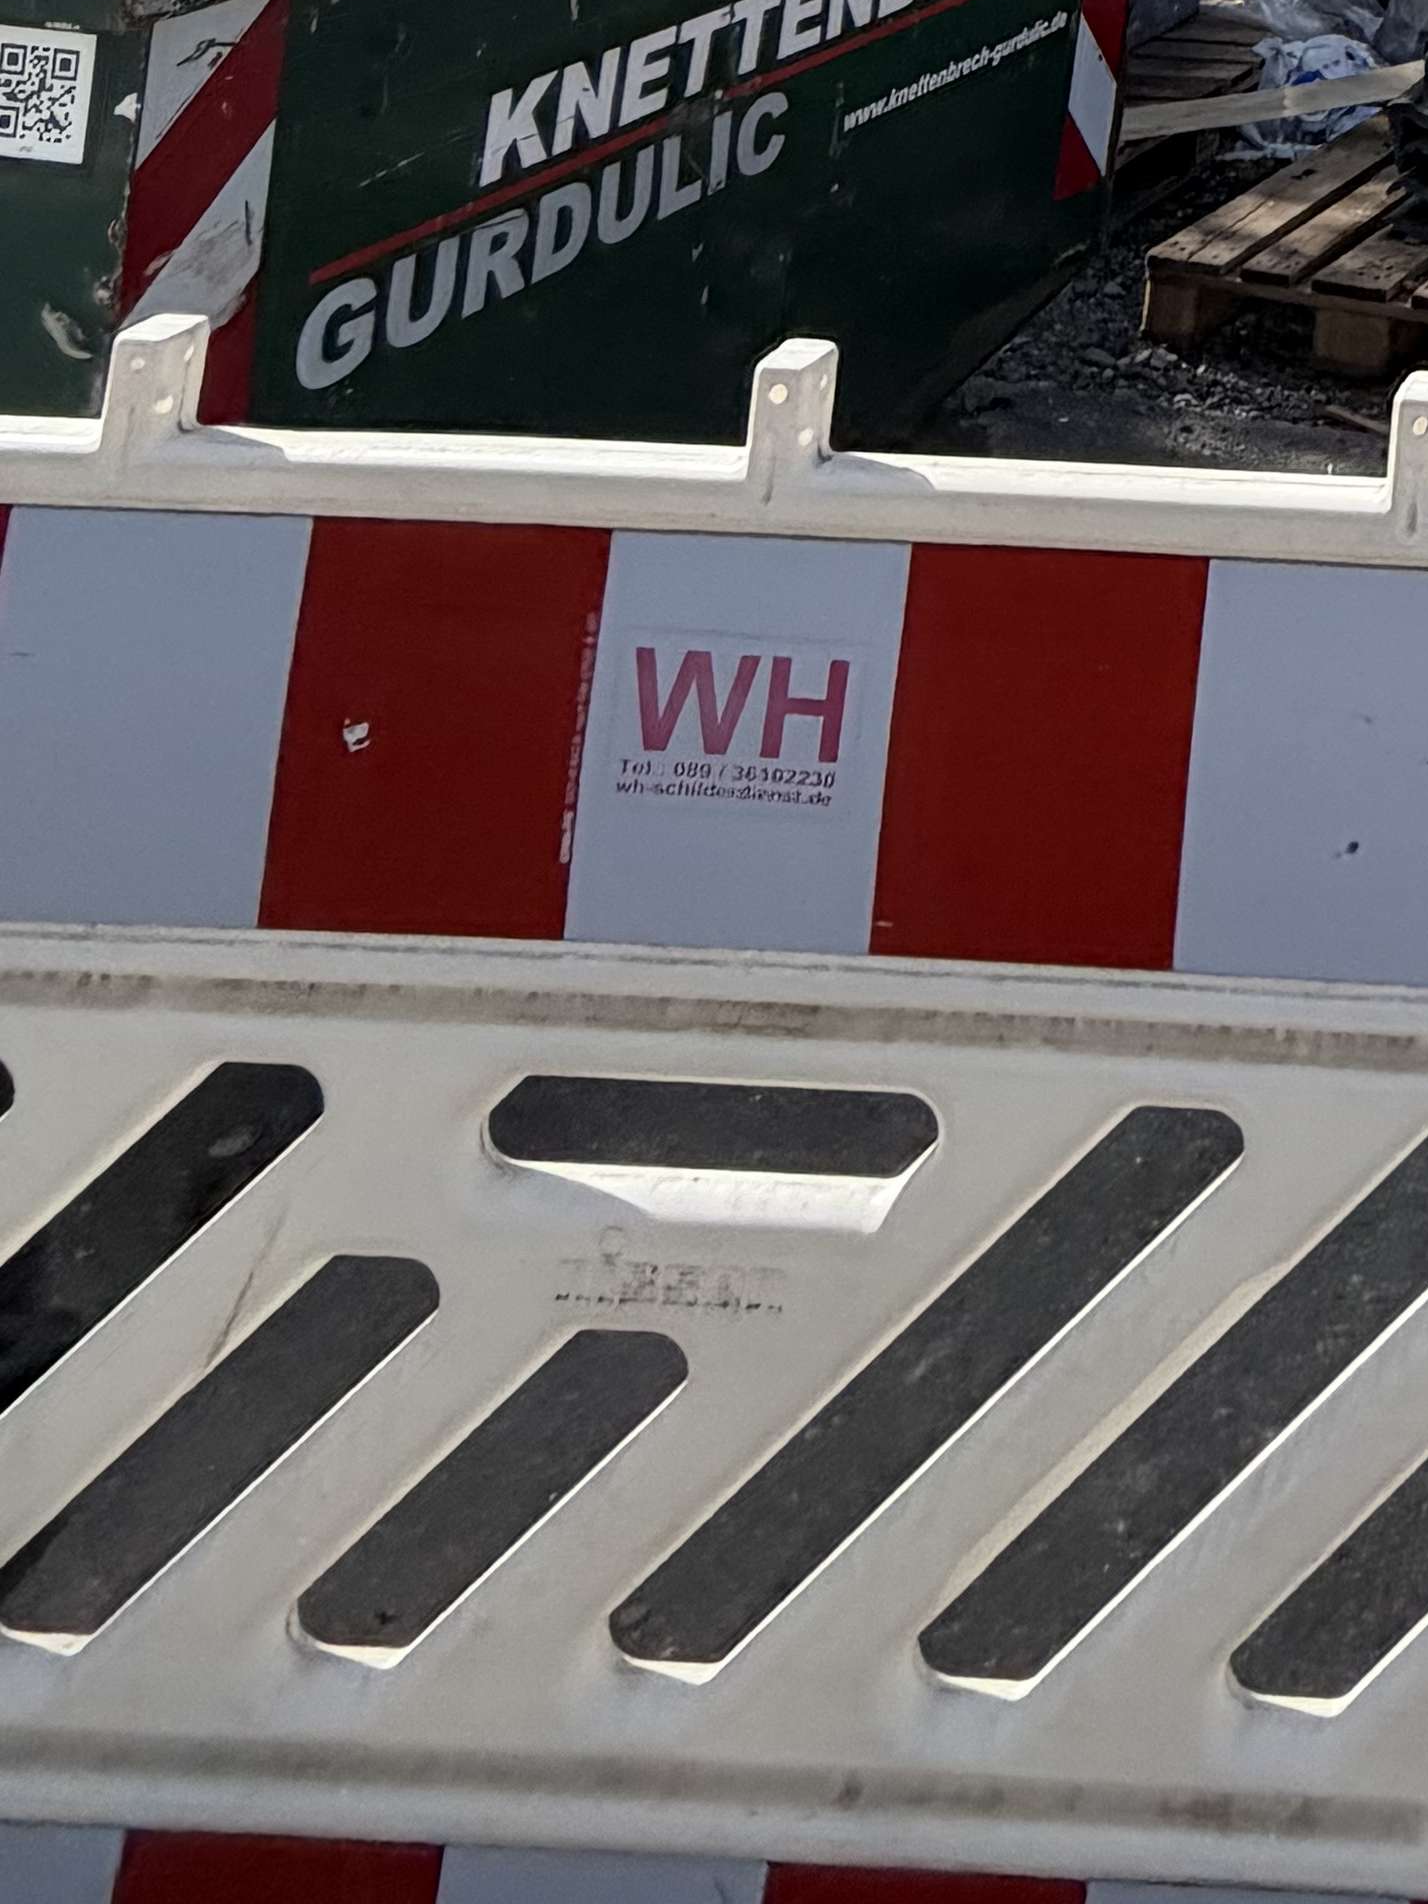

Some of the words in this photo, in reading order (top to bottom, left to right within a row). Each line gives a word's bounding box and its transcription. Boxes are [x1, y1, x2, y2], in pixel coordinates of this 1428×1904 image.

[843, 10, 1068, 133] www.knettenbrech-gurdulic.de
[294, 91, 790, 390] GURDULIC
[635, 646, 851, 763] WH
